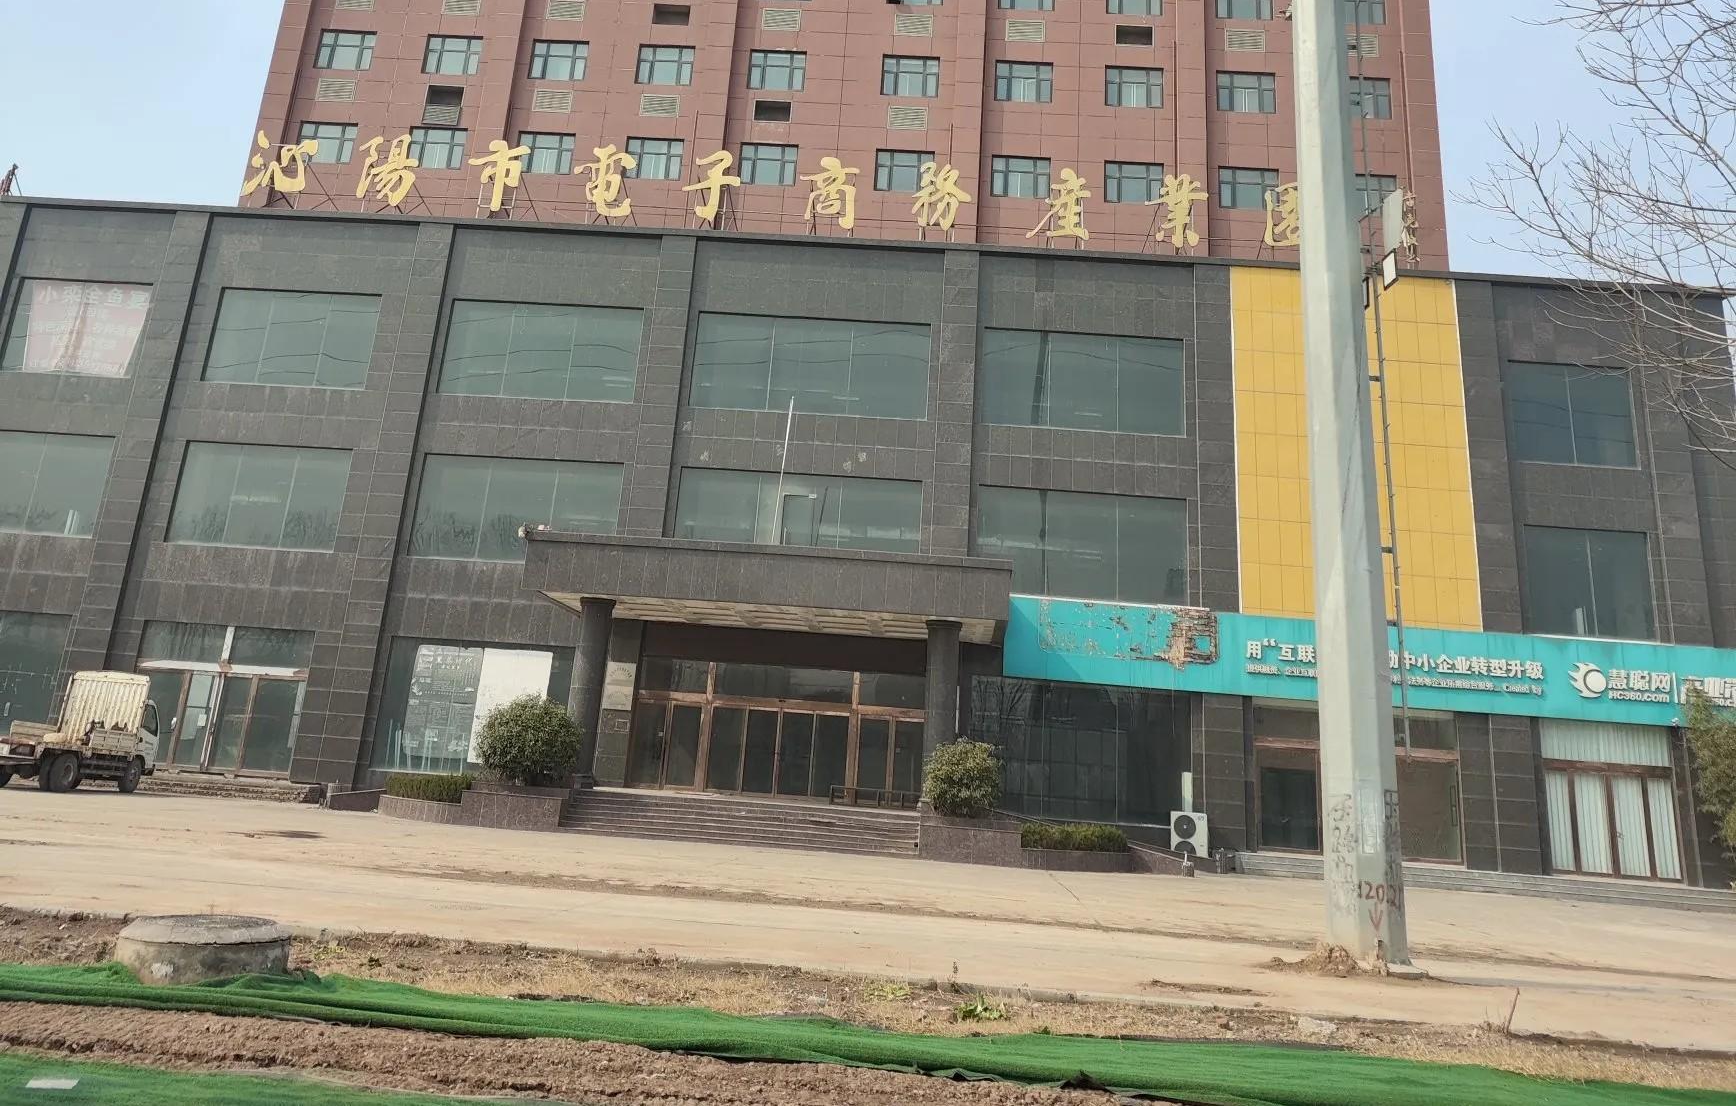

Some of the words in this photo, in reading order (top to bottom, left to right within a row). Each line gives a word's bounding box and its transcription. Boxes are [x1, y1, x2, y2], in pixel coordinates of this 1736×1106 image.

[1608, 668, 1671, 692] 慧聪网
[1608, 689, 1670, 703] HC360.com
